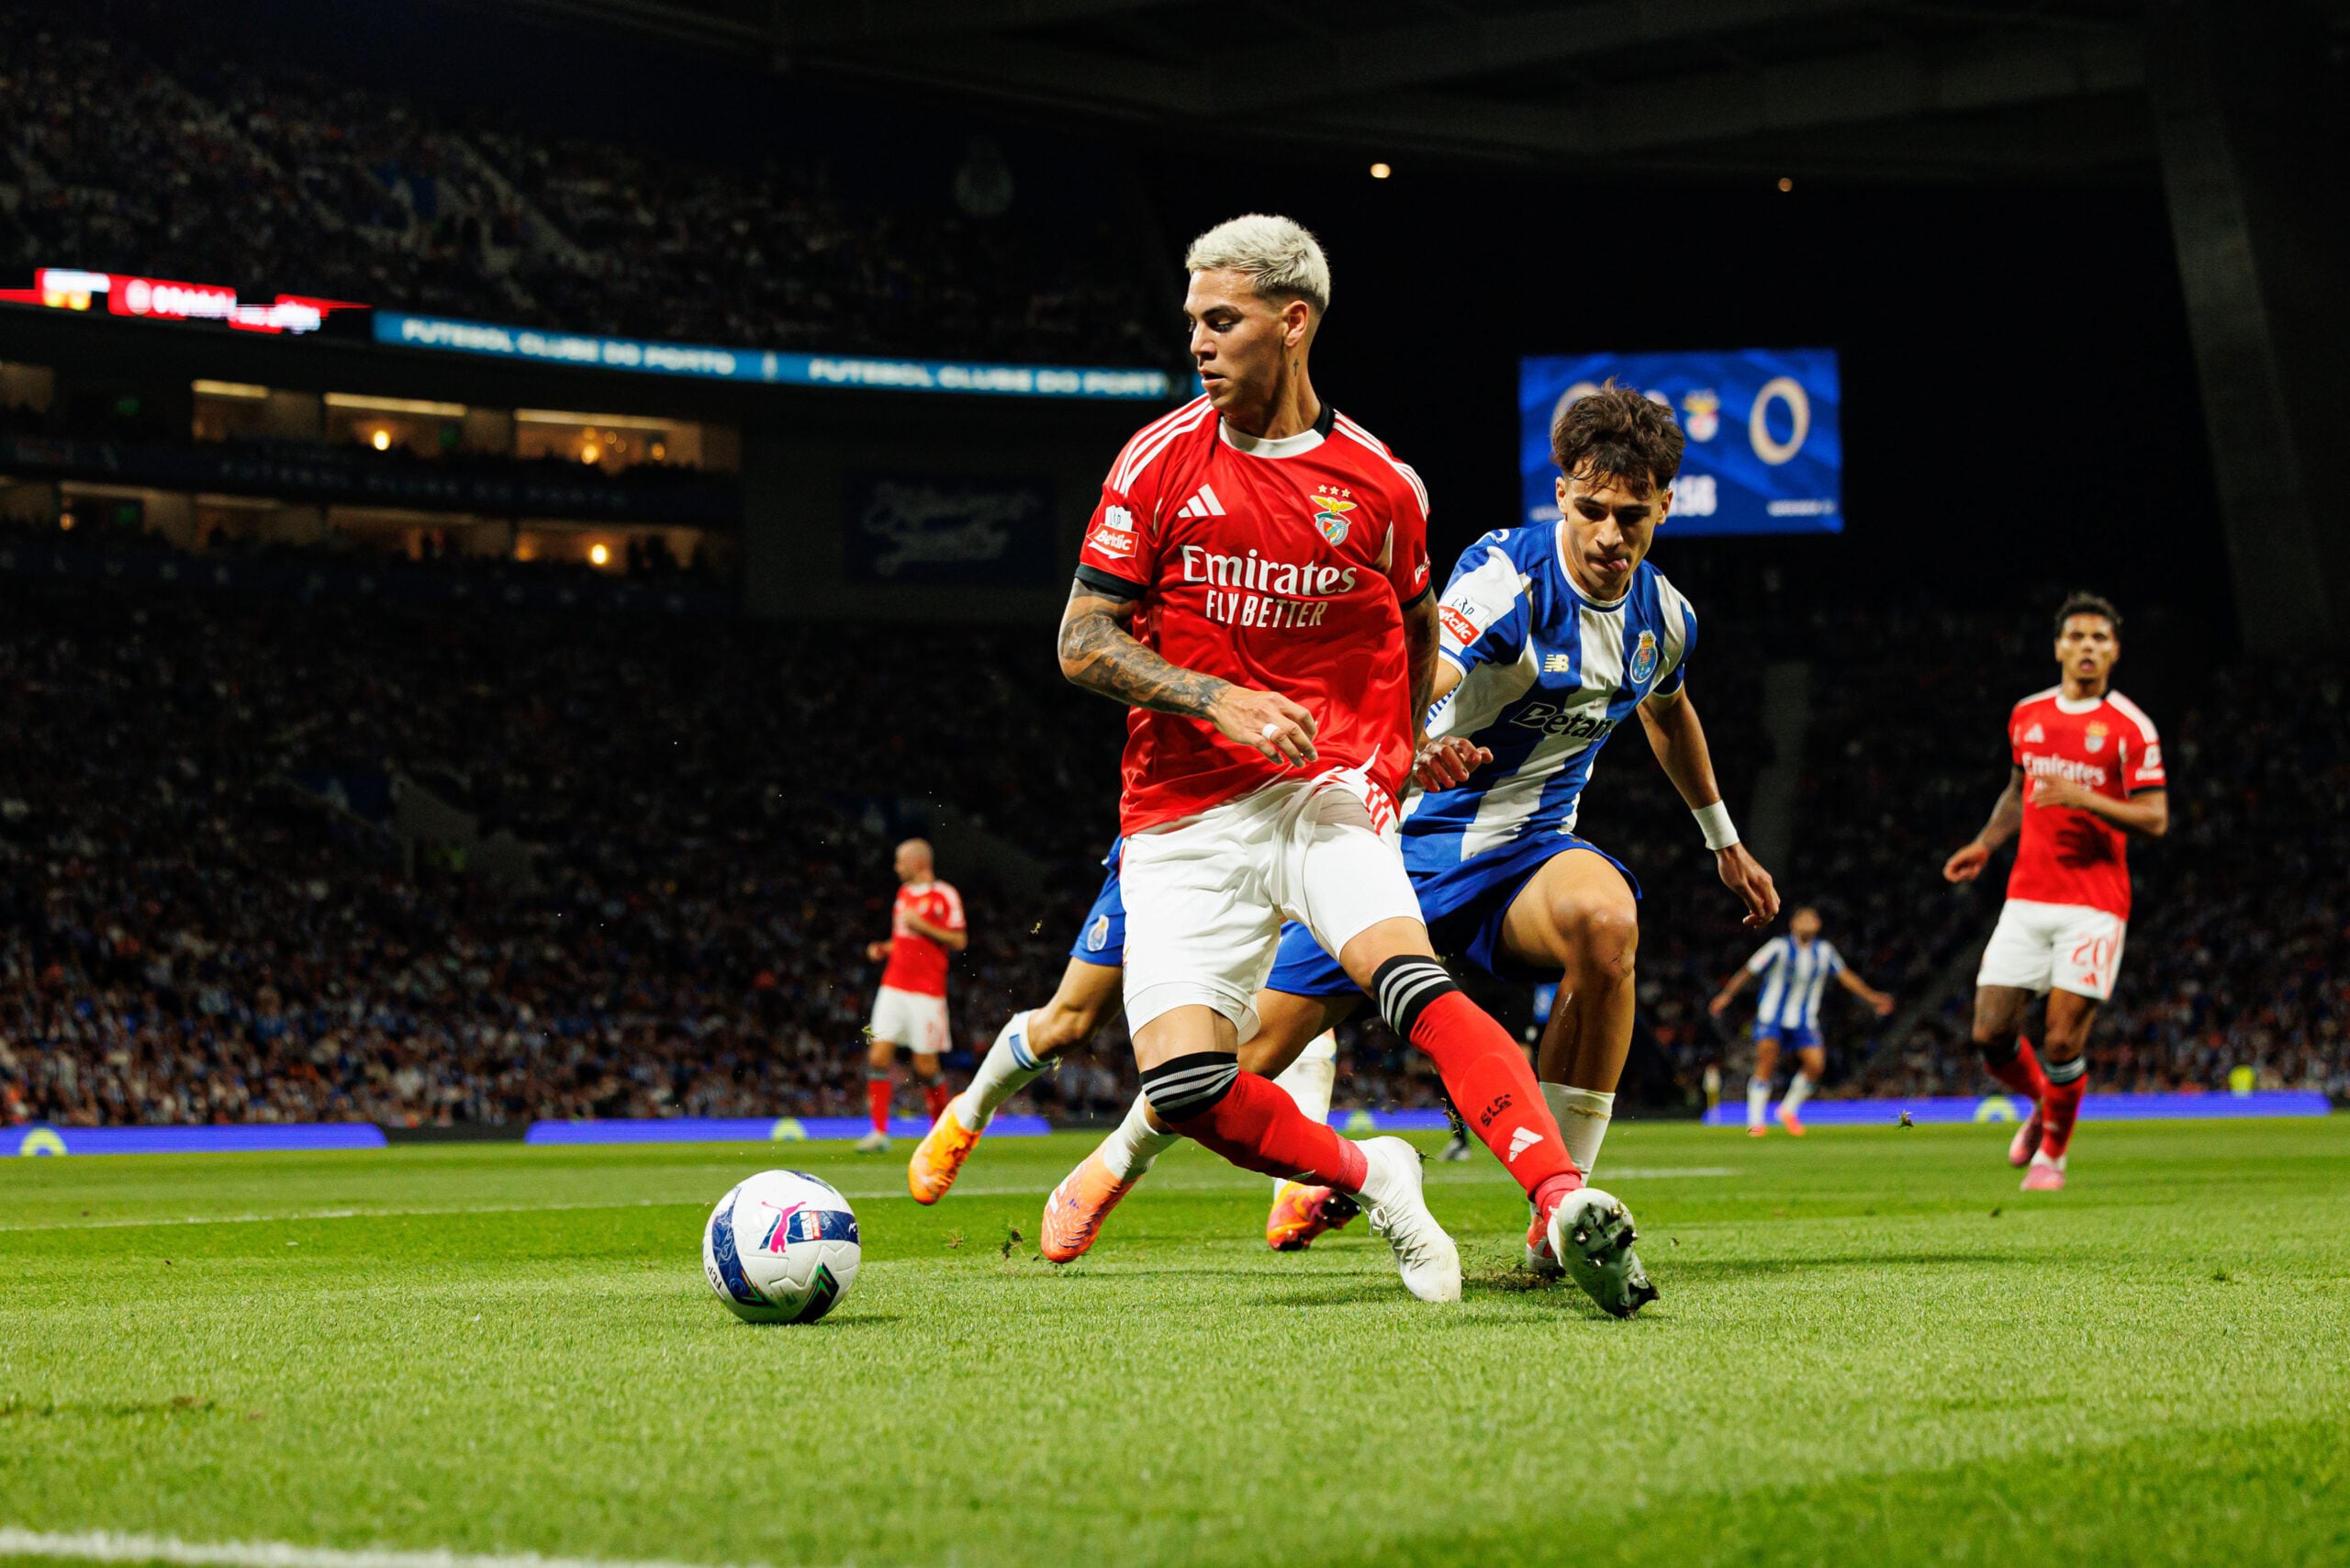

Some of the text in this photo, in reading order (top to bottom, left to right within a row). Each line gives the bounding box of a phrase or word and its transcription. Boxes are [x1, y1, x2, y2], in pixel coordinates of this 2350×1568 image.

[603, 342, 640, 365] DO
[644, 345, 735, 375] PORTO
[1036, 369, 1079, 392] DO
[1749, 376, 1809, 465] 0
[1181, 545, 1357, 596] Emirates
[1206, 589, 1328, 628] FLY BETTER
[1509, 701, 1617, 741] Betan
[2022, 752, 2106, 786] Emirates
[2071, 931, 2109, 970] 20
